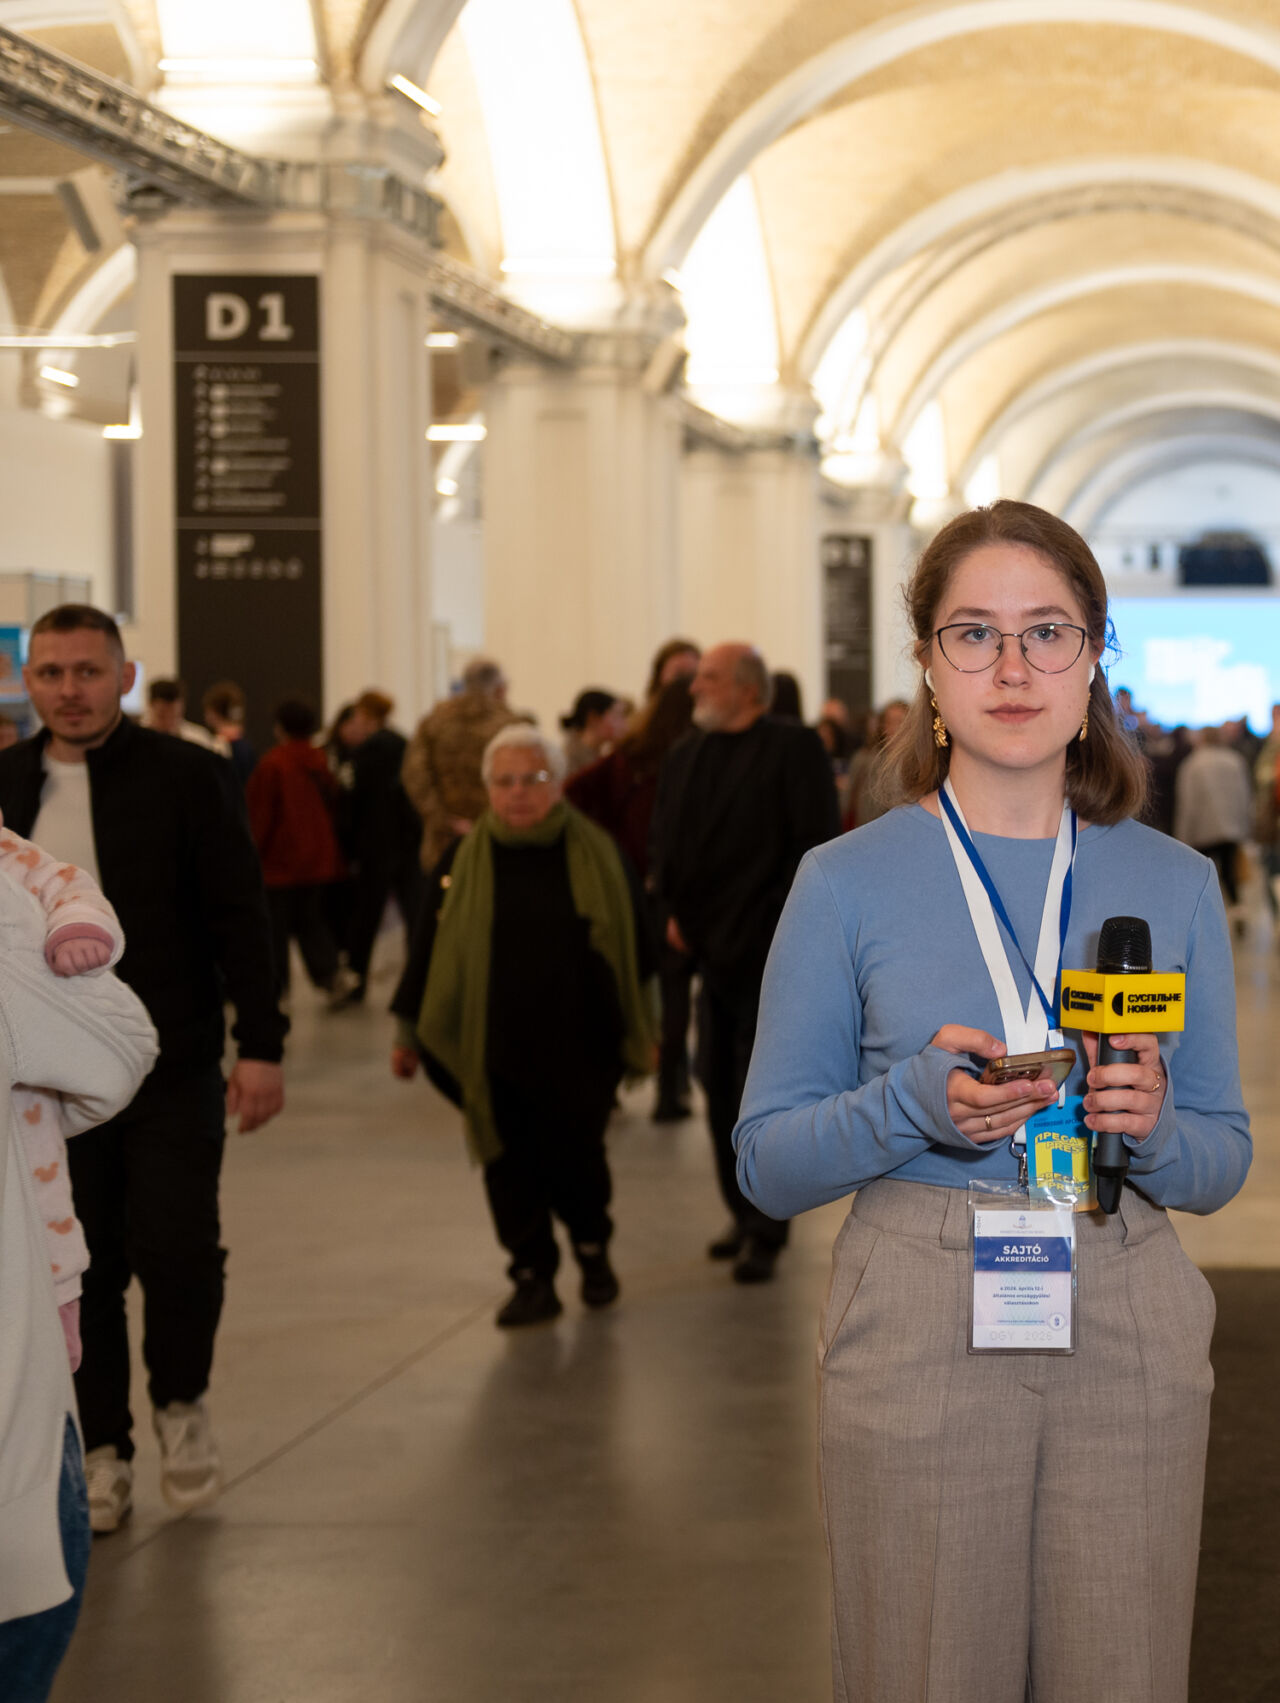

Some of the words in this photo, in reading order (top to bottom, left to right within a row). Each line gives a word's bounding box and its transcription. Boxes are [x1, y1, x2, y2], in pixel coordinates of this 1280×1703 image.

[1127, 992, 1182, 1003] СУСПІЛЬНЕ
[1127, 1004, 1167, 1014] НОВИНИ
[1034, 1131, 1079, 1144] ПРЕСА
[1002, 1243, 1042, 1255] SAJTÓ
[994, 1255, 1050, 1263] AKKREDITÁCIÓ
